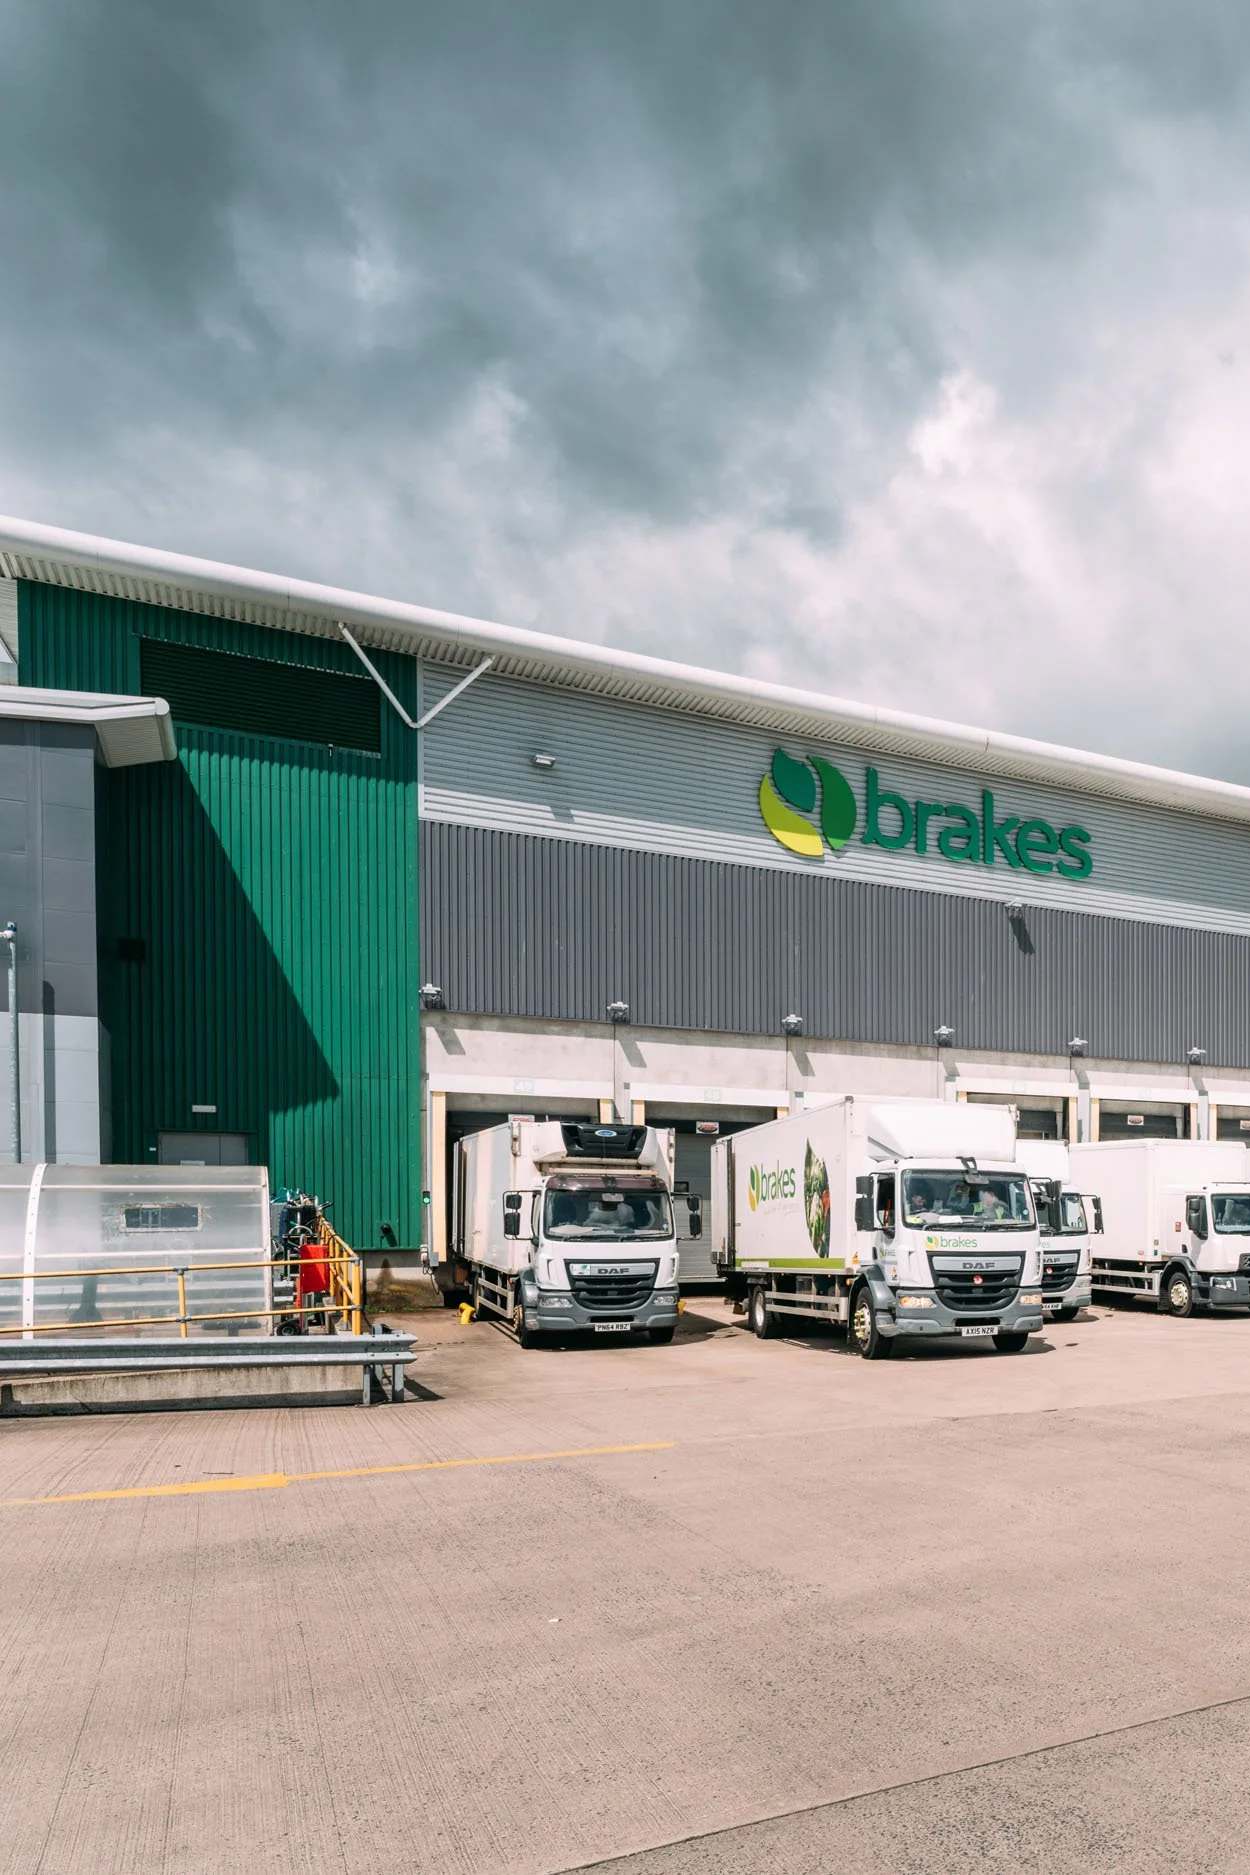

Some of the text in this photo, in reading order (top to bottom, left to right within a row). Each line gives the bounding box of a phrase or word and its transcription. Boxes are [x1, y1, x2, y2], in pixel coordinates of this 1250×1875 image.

[861, 766, 1093, 879] brakes
[761, 1159, 796, 1202] brakes
[940, 1236, 978, 1248] brakes
[597, 1267, 630, 1275] DAF
[962, 1262, 995, 1270] DAF
[982, 1327, 995, 1335] NZR
